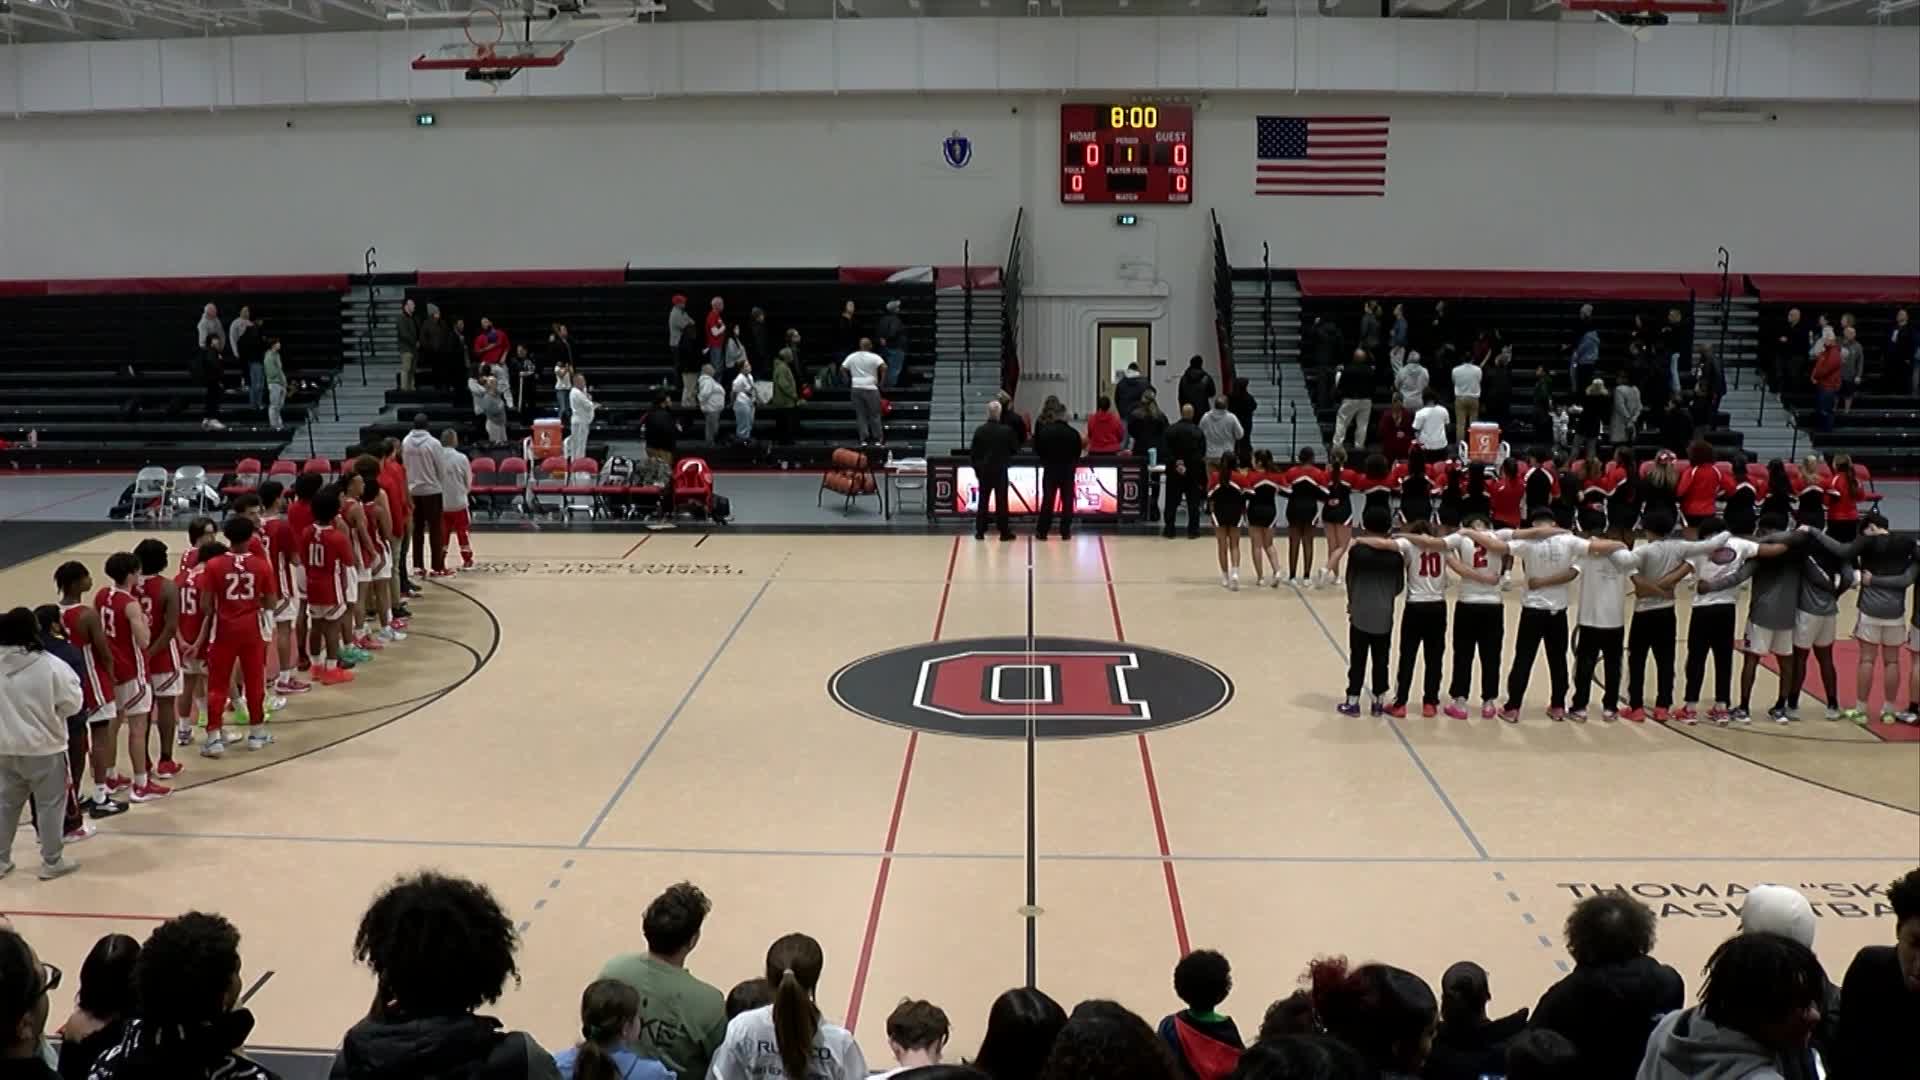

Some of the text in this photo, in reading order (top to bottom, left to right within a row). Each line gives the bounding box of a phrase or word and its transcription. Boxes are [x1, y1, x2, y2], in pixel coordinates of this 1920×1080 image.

[1111, 107, 1157, 128] 8:00
[1070, 132, 1096, 141] HOME
[1156, 132, 1186, 141] GUEST
[1086, 144, 1099, 166] 0
[1174, 144, 1187, 166] 0
[1072, 175, 1082, 191] 0
[1176, 175, 1187, 191] 0
[309, 543, 324, 566] 10
[1419, 552, 1441, 577] 10
[1473, 542, 1488, 568] 2
[225, 573, 255, 600] 23
[181, 587, 197, 614] 15
[913, 651, 1151, 720] D
[1557, 883, 1778, 898] THOMA
